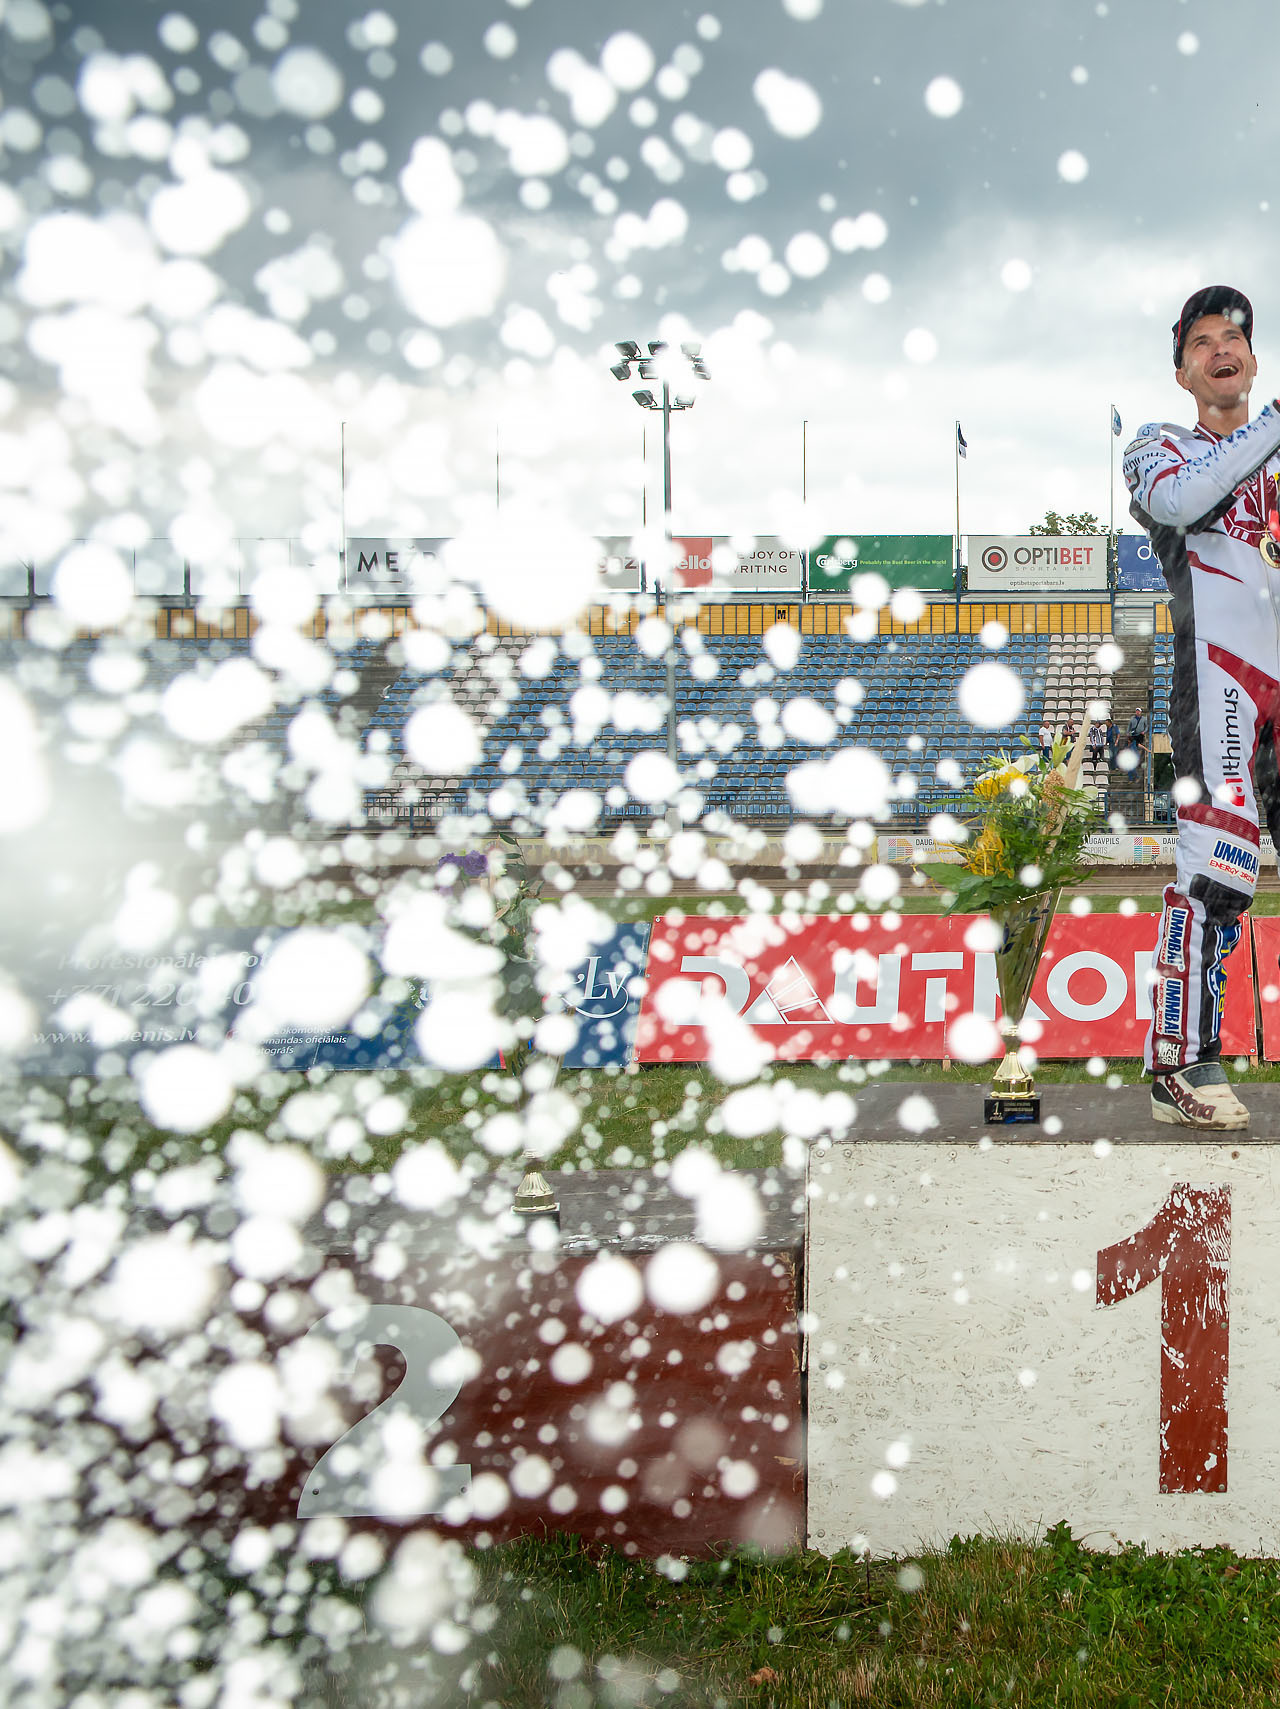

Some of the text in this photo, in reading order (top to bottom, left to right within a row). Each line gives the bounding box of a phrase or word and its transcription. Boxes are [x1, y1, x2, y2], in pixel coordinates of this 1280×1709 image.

[749, 551, 774, 560] JOY
[783, 551, 796, 560] OF
[859, 559, 882, 567] Probably
[1014, 547, 1093, 565] OPTIBET
[1209, 859, 1239, 876] ENERGY
[674, 951, 1224, 1025] DAUTKO
[1164, 980, 1181, 1038] UMMBA!
[260, 1035, 303, 1044] omandas
[257, 1046, 294, 1056] togrāfs
[1096, 1181, 1232, 1494] 1
[296, 1304, 472, 1519] 2
